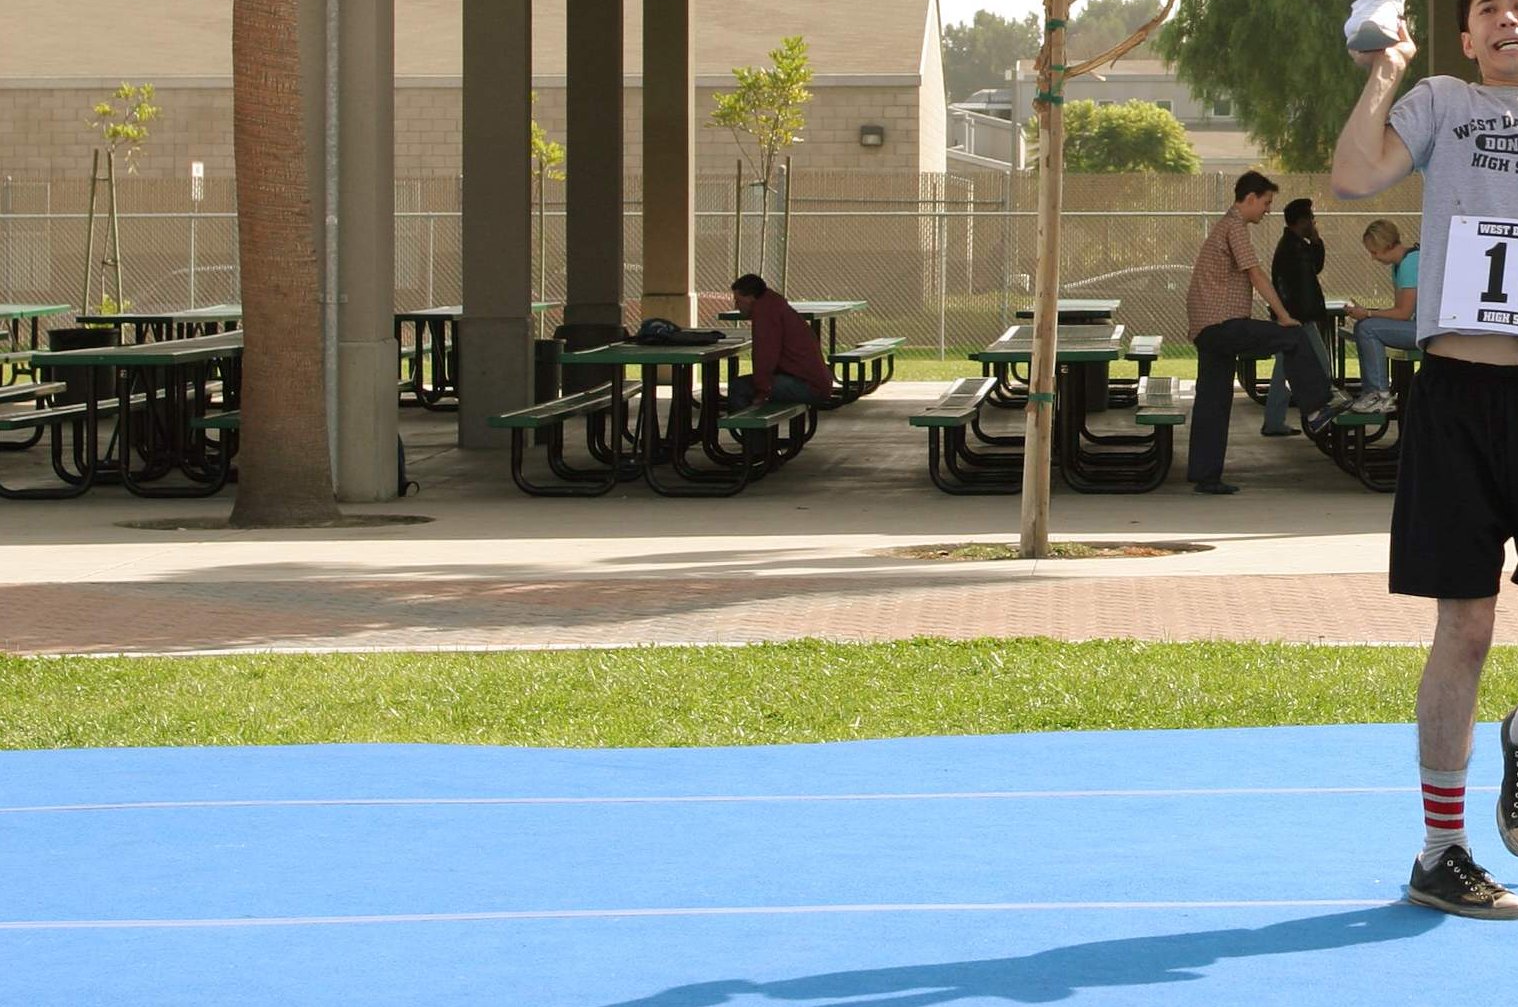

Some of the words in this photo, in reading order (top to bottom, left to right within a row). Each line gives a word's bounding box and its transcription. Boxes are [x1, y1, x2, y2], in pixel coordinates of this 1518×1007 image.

[1453, 118, 1497, 139] WEST
[1471, 153, 1510, 172] HIGH
[1480, 223, 1511, 235] WEST
[1482, 311, 1510, 323] HIGH
